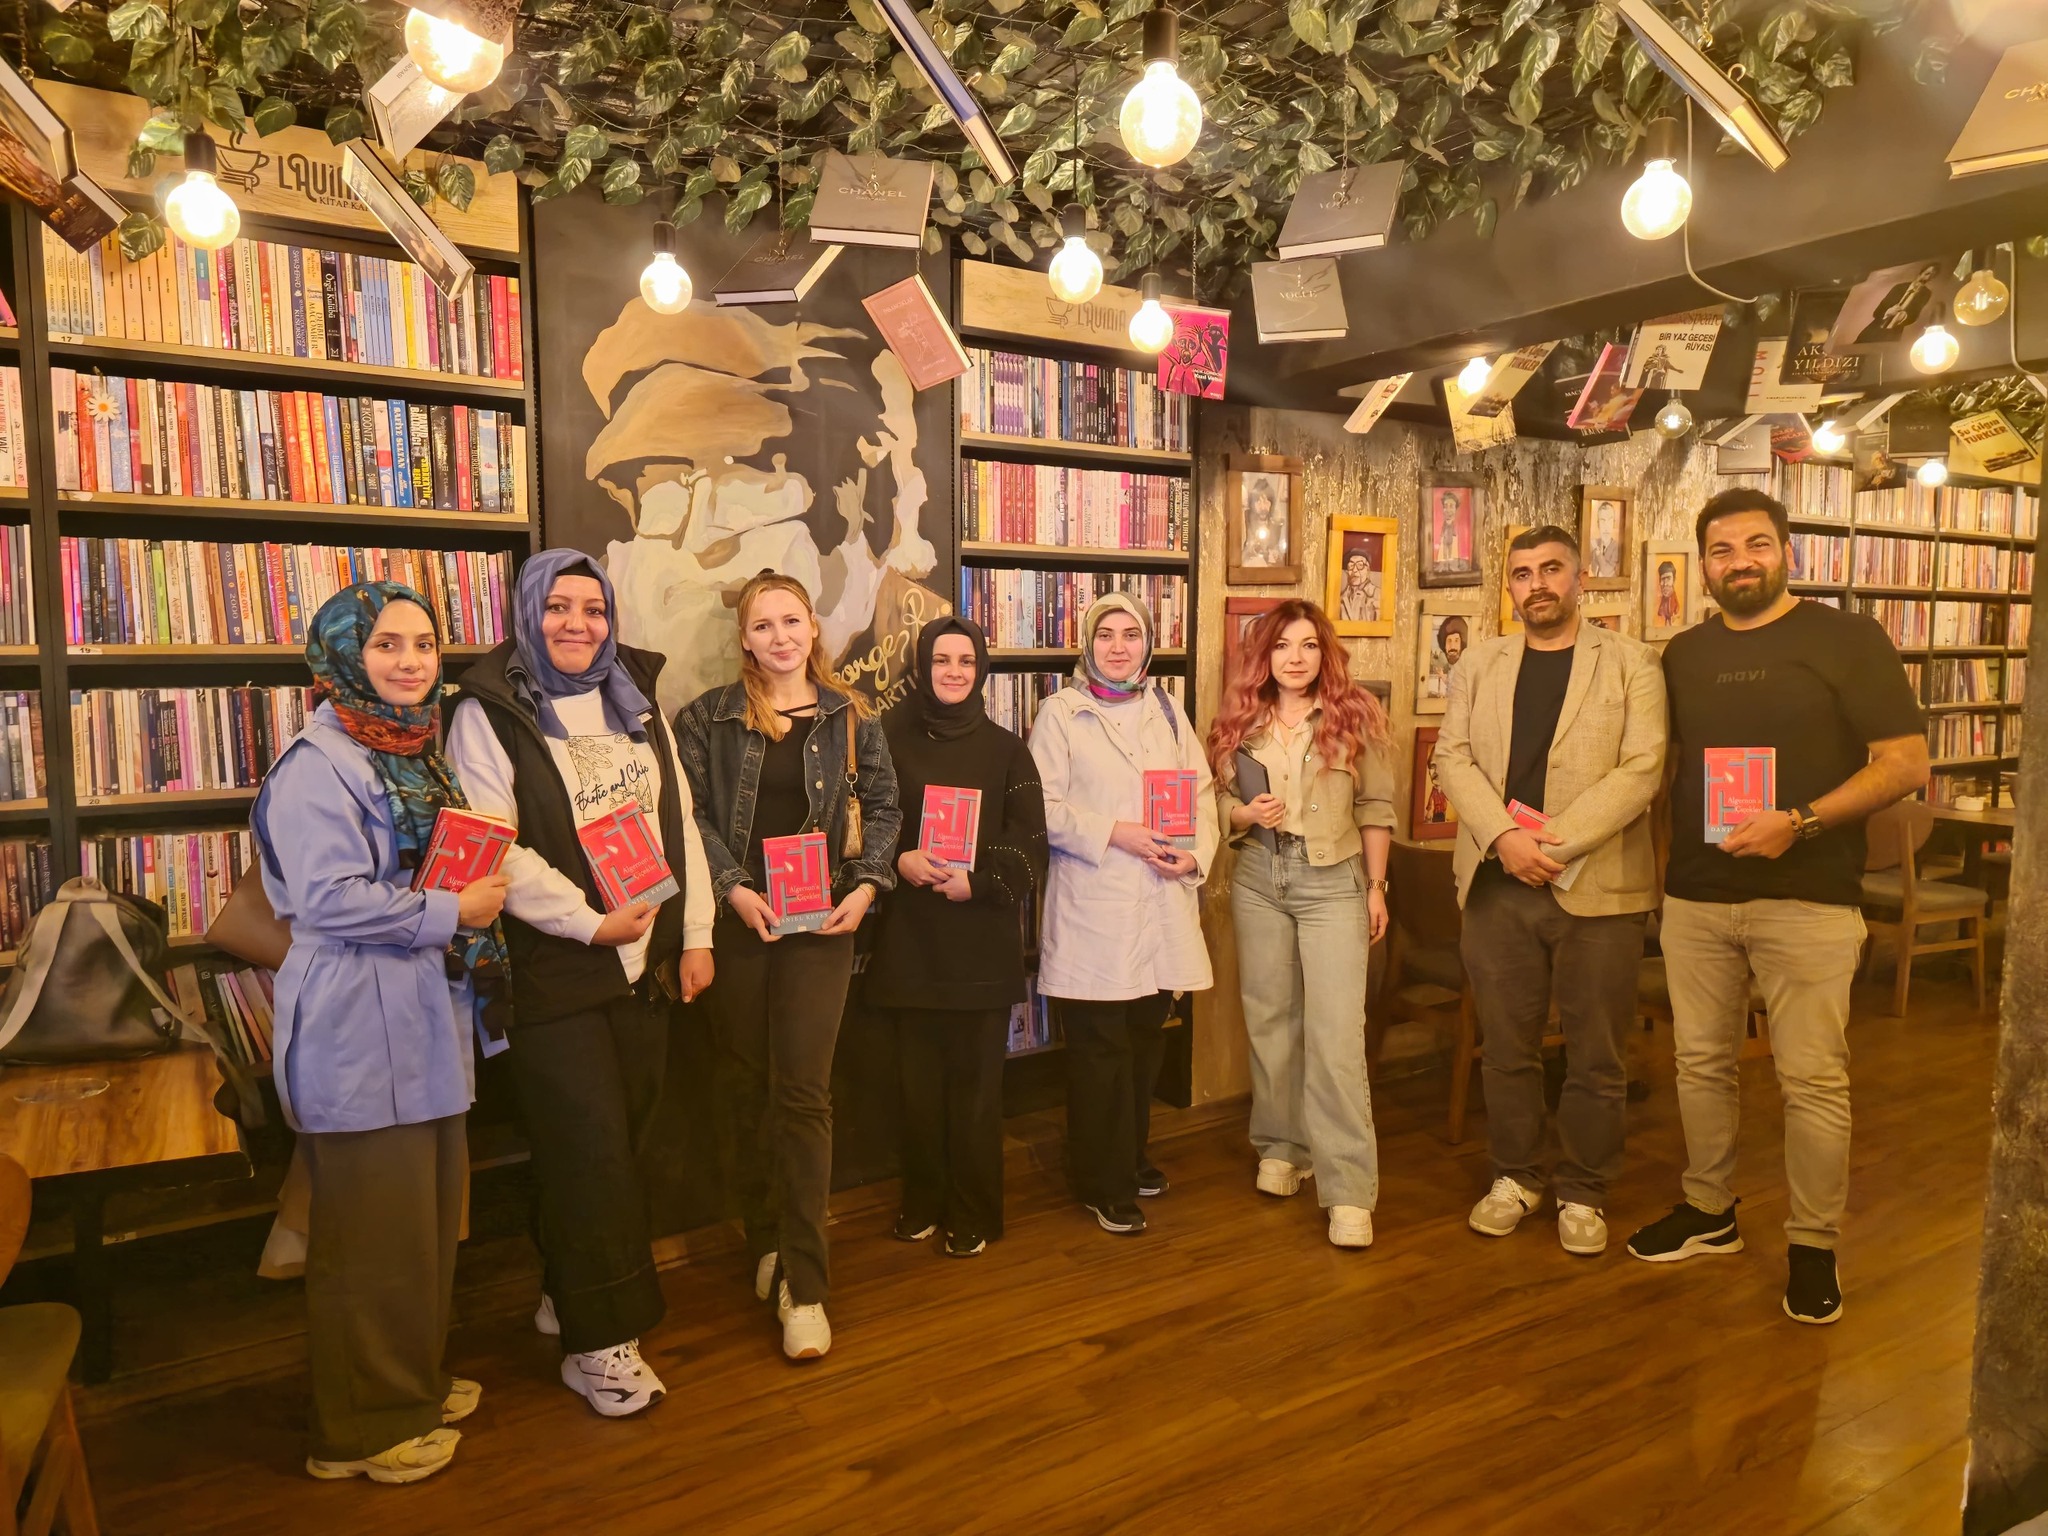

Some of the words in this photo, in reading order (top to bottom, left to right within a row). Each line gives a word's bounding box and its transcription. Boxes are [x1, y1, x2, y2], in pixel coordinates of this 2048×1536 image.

[838, 186, 907, 199] CHANEL
[324, 273, 335, 293] Örgü
[1279, 289, 1320, 300] VOGUE
[327, 293, 337, 319] Kulübü
[308, 301, 318, 349] MACOMBER
[1658, 332, 1672, 341] BİR
[1673, 333, 1688, 341] YAZ
[1688, 332, 1716, 343] GECESİ
[1684, 342, 1712, 353] RÜYASI
[1793, 356, 1860, 371] YILDIZI
[361, 412, 375, 443] KOONTZ
[393, 407, 403, 436] SAFİYE
[410, 407, 422, 446] BALDACCI
[419, 413, 429, 439] DAVID
[395, 437, 406, 469] SULTAN
[379, 468, 393, 490] YOL
[420, 458, 433, 499] SADAKATİN
[229, 593, 239, 620] 2000
[241, 599, 250, 621] OYUN
[290, 604, 300, 620] ARENA
[451, 597, 462, 619] CAM
[454, 621, 463, 634] EV
[1716, 669, 1766, 685] mavi
[574, 782, 609, 812] Exotic
[609, 767, 629, 792] and
[625, 758, 650, 784] Chic
[1710, 825, 1735, 834] DANI
[650, 879, 672, 896] KEYES
